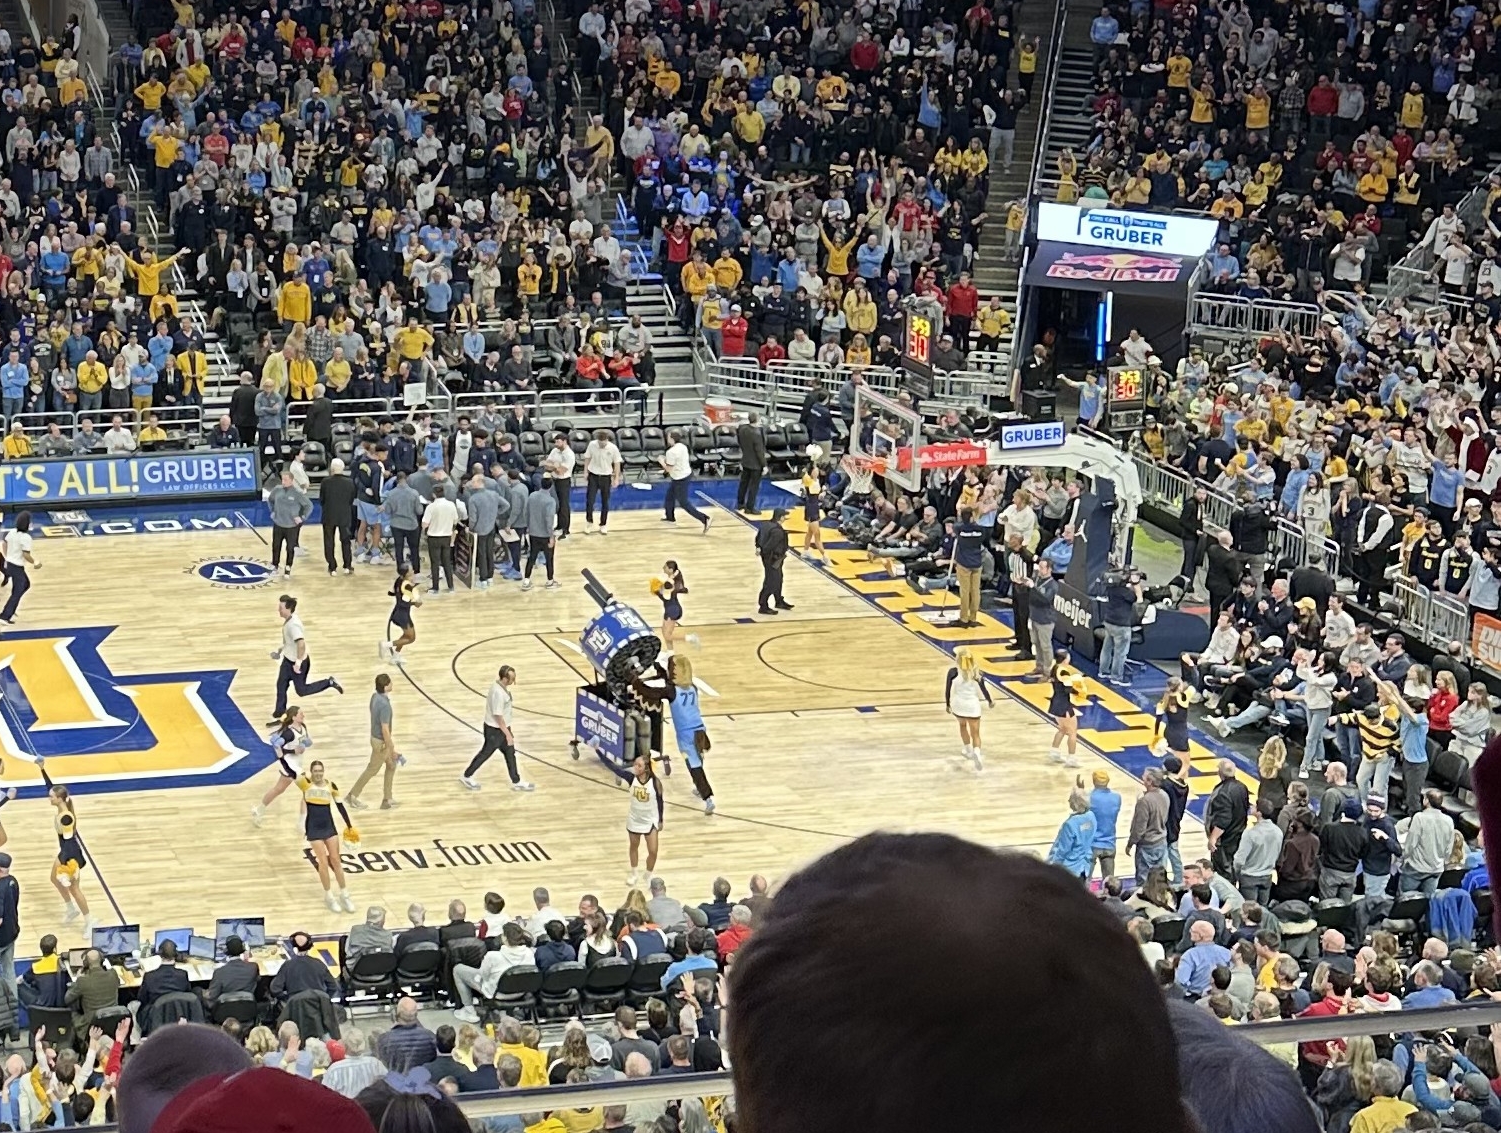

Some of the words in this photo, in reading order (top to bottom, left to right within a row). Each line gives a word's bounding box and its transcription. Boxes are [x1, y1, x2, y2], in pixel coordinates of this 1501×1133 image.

[1091, 226, 1163, 246] GRUBER
[1046, 265, 1113, 281] Red
[1112, 267, 1180, 282] Bull
[909, 332, 930, 362] 30
[1117, 383, 1137, 399] 30
[1004, 428, 1062, 444] GRUBER
[59, 458, 139, 497] ALL!
[143, 458, 252, 484] GRUBER
[210, 565, 270, 580] AL
[1053, 594, 1092, 629] meijer
[680, 691, 696, 706] 77
[581, 716, 618, 746] GRUBER
